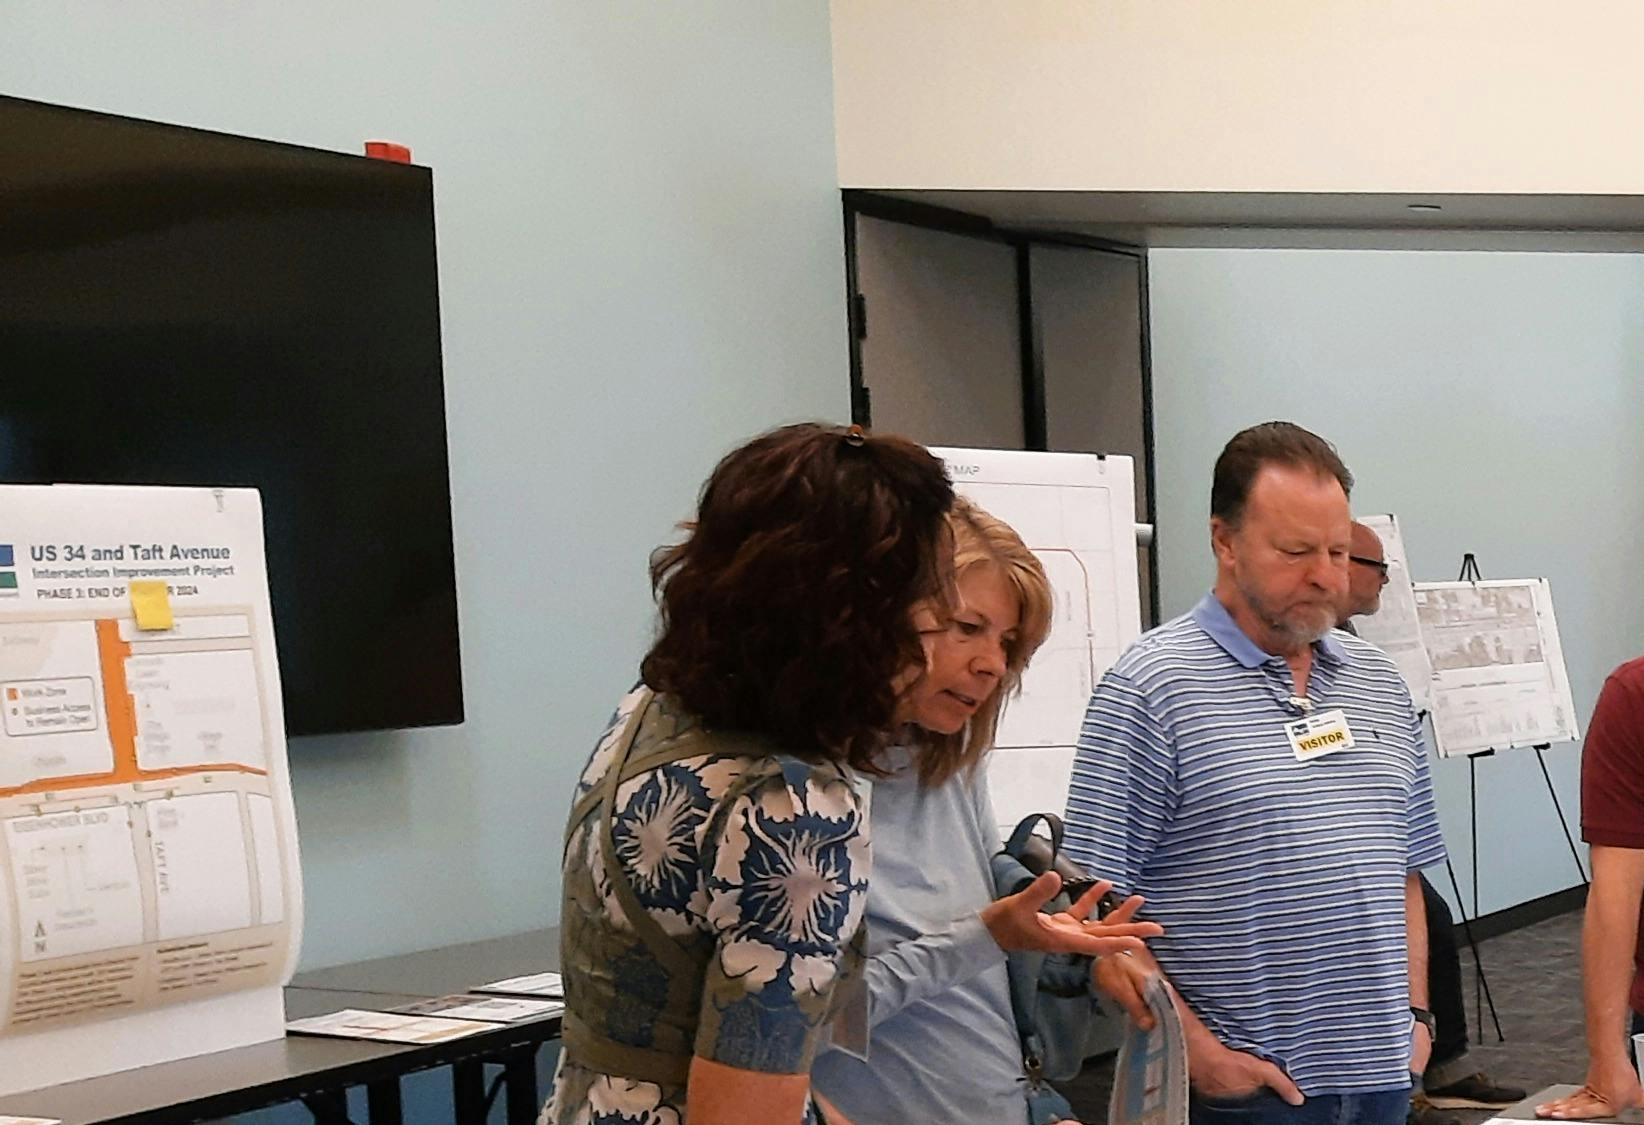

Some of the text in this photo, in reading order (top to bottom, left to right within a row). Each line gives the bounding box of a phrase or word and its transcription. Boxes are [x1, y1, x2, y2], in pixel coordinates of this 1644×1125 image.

[953, 465, 981, 476] MAP
[30, 544, 231, 562] US 34 and Taft Avenue
[32, 565, 235, 579] Intersection Improvement Project
[37, 588, 72, 600] PHASE
[88, 587, 110, 599] END
[112, 587, 126, 598] OF
[1299, 731, 1345, 751] VISITOR
